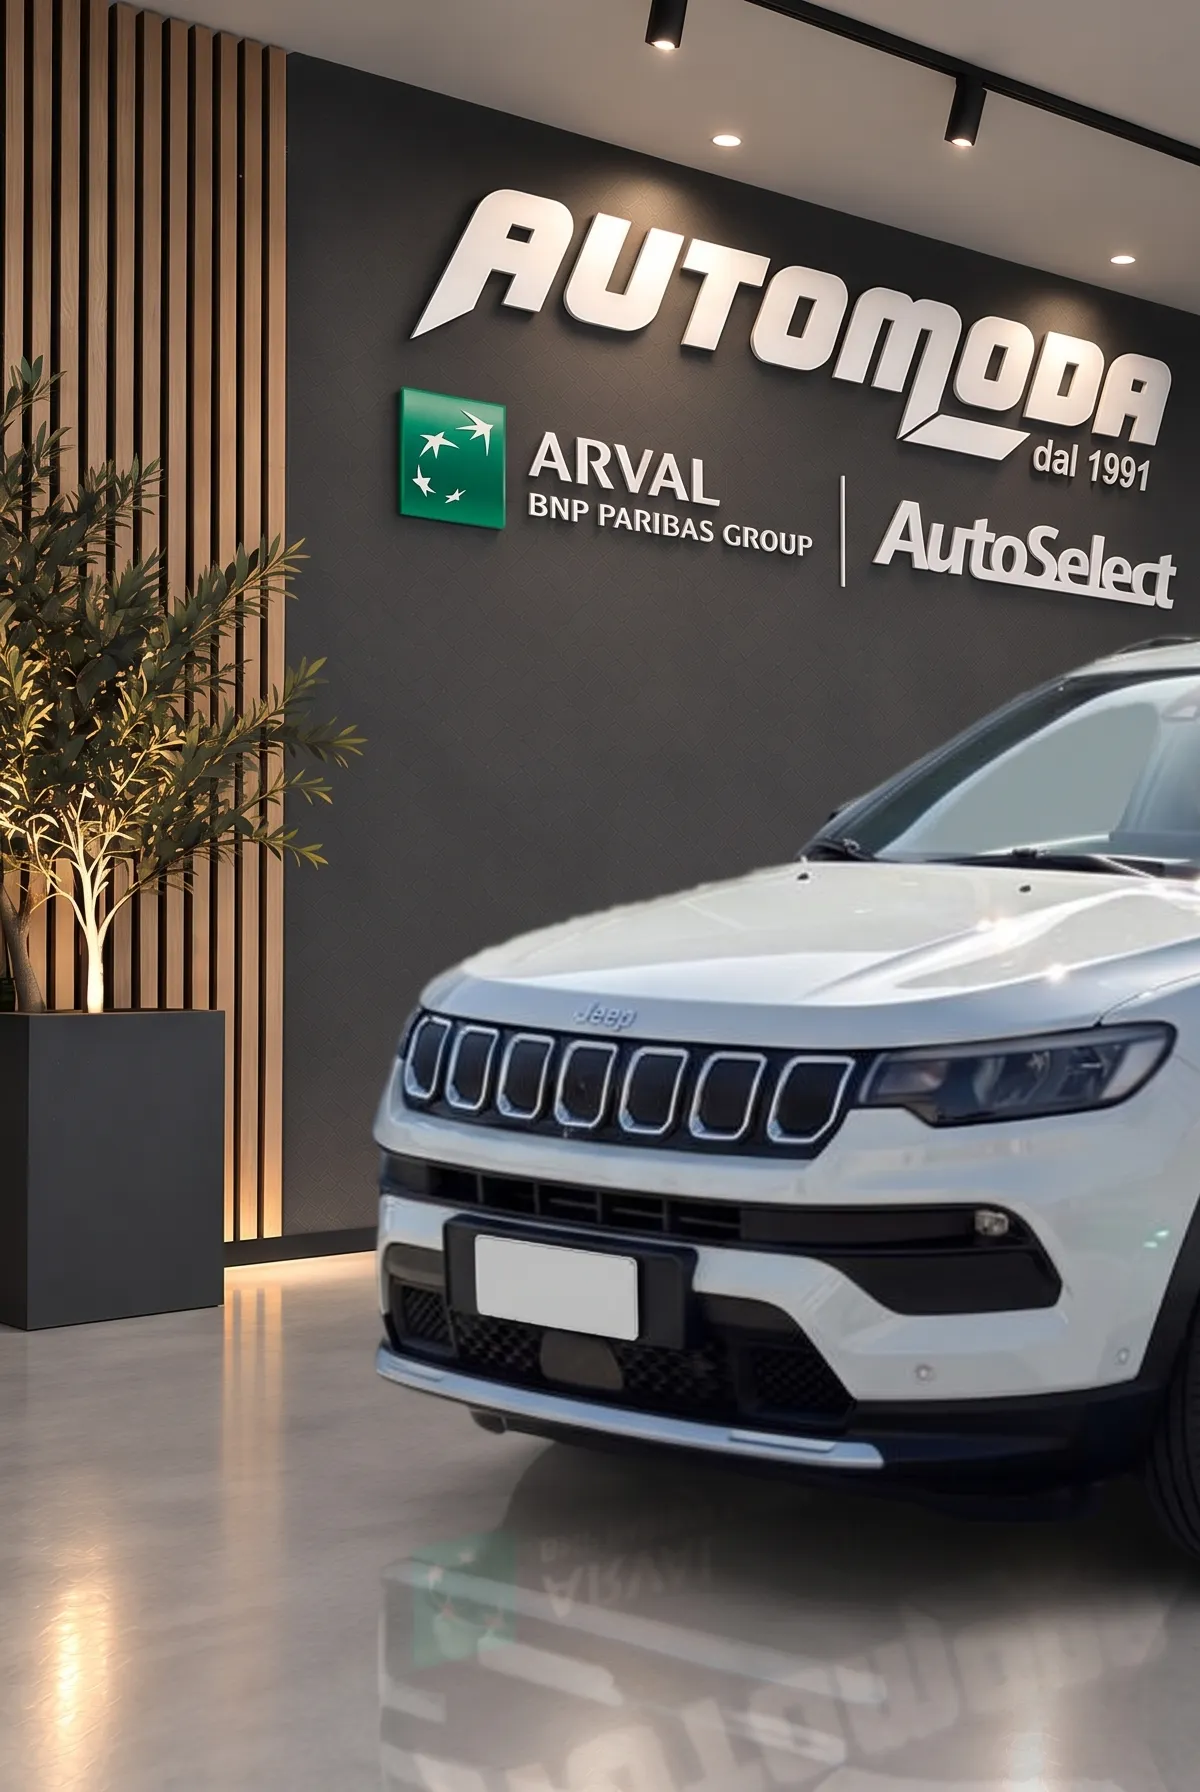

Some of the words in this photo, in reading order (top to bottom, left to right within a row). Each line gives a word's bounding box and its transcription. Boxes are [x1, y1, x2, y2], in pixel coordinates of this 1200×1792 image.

[410, 188, 1173, 461] AUTOMODA
[528, 431, 720, 507] ARVAL
[1033, 439, 1078, 477] dal
[1088, 449, 1150, 491] 1991
[528, 492, 589, 522] BNP
[597, 503, 714, 542] PARIBAS
[723, 523, 814, 556] GROUP
[874, 499, 1177, 609] AutoSelect
[572, 1000, 637, 1032] Jeep
